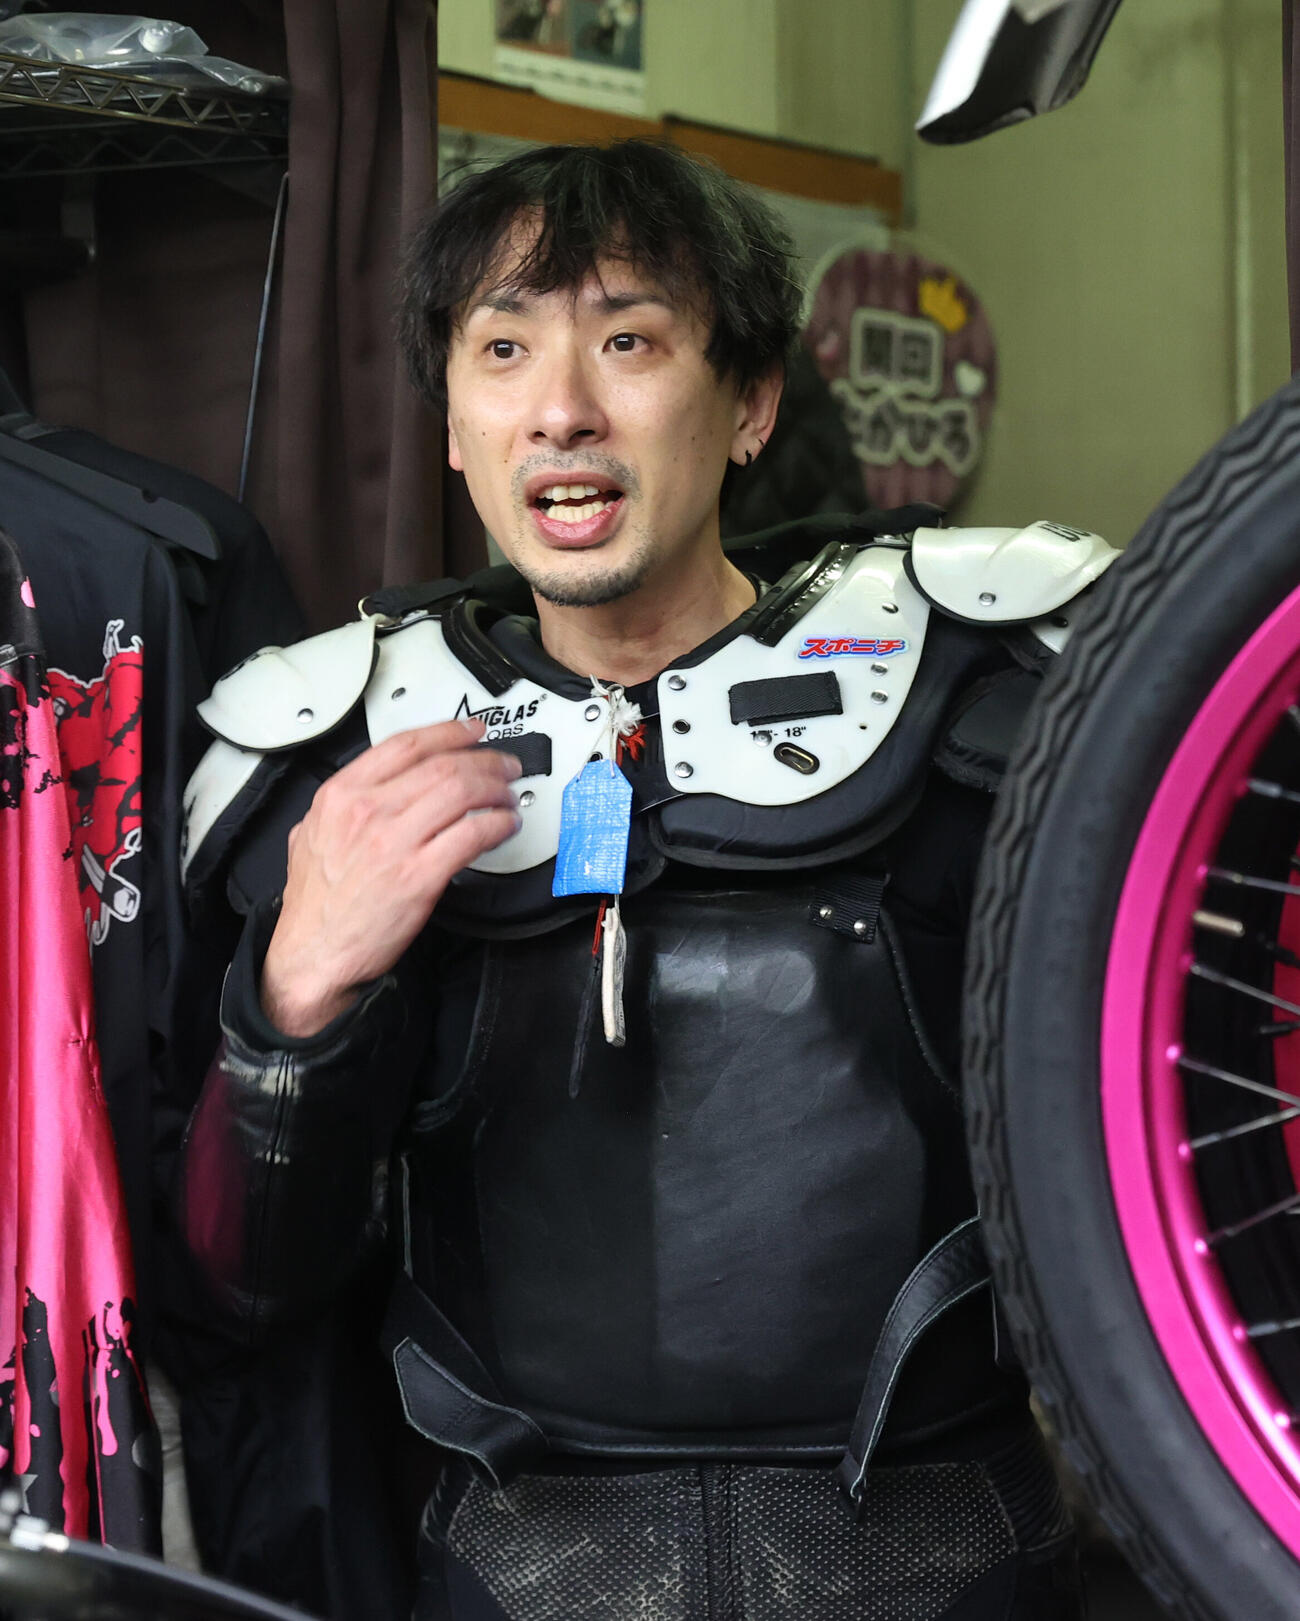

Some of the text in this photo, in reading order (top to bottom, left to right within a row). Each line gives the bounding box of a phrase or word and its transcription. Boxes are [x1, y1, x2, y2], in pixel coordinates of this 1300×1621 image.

[799, 638, 904, 657] スポニチ
[455, 692, 540, 727] UGLAS
